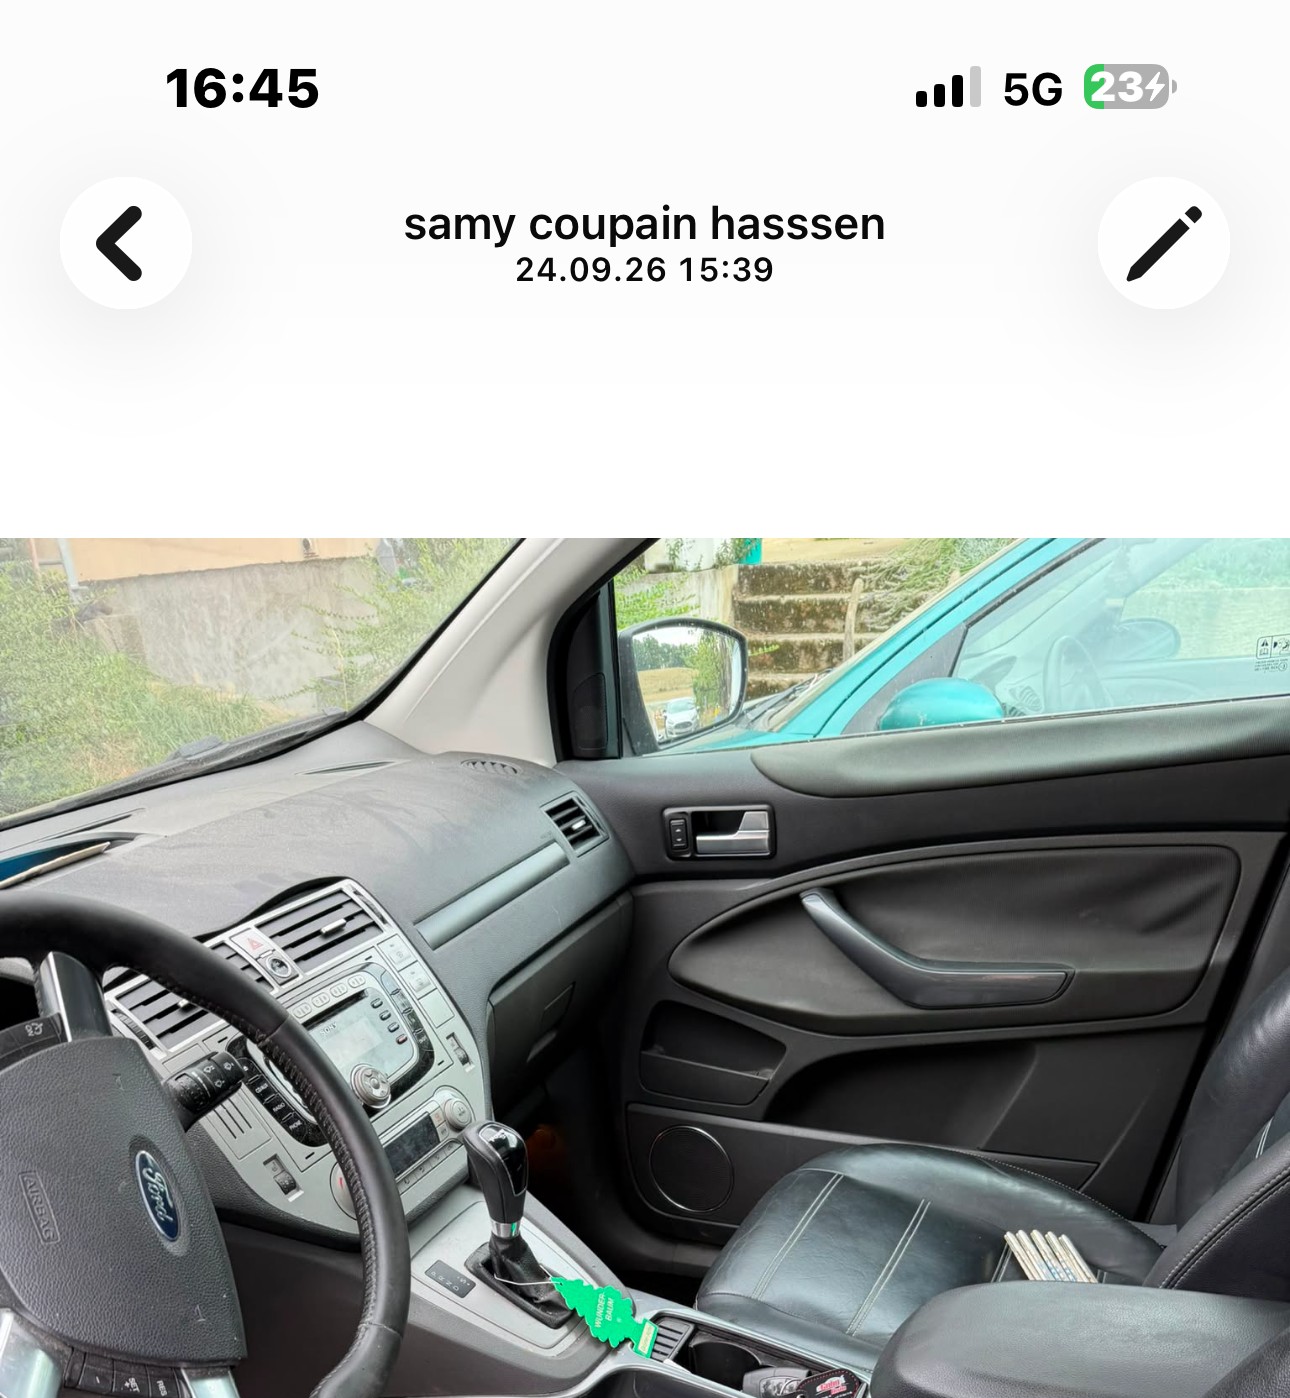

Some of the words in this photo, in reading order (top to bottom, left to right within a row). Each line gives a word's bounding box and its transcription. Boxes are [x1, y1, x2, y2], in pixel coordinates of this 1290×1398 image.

[142, 1167, 174, 1222] Ford
[23, 1175, 56, 1241] AIRBAG
[605, 1297, 614, 1321] BAUM
[128, 1377, 140, 1393] SET
[156, 1379, 168, 1397] RES
